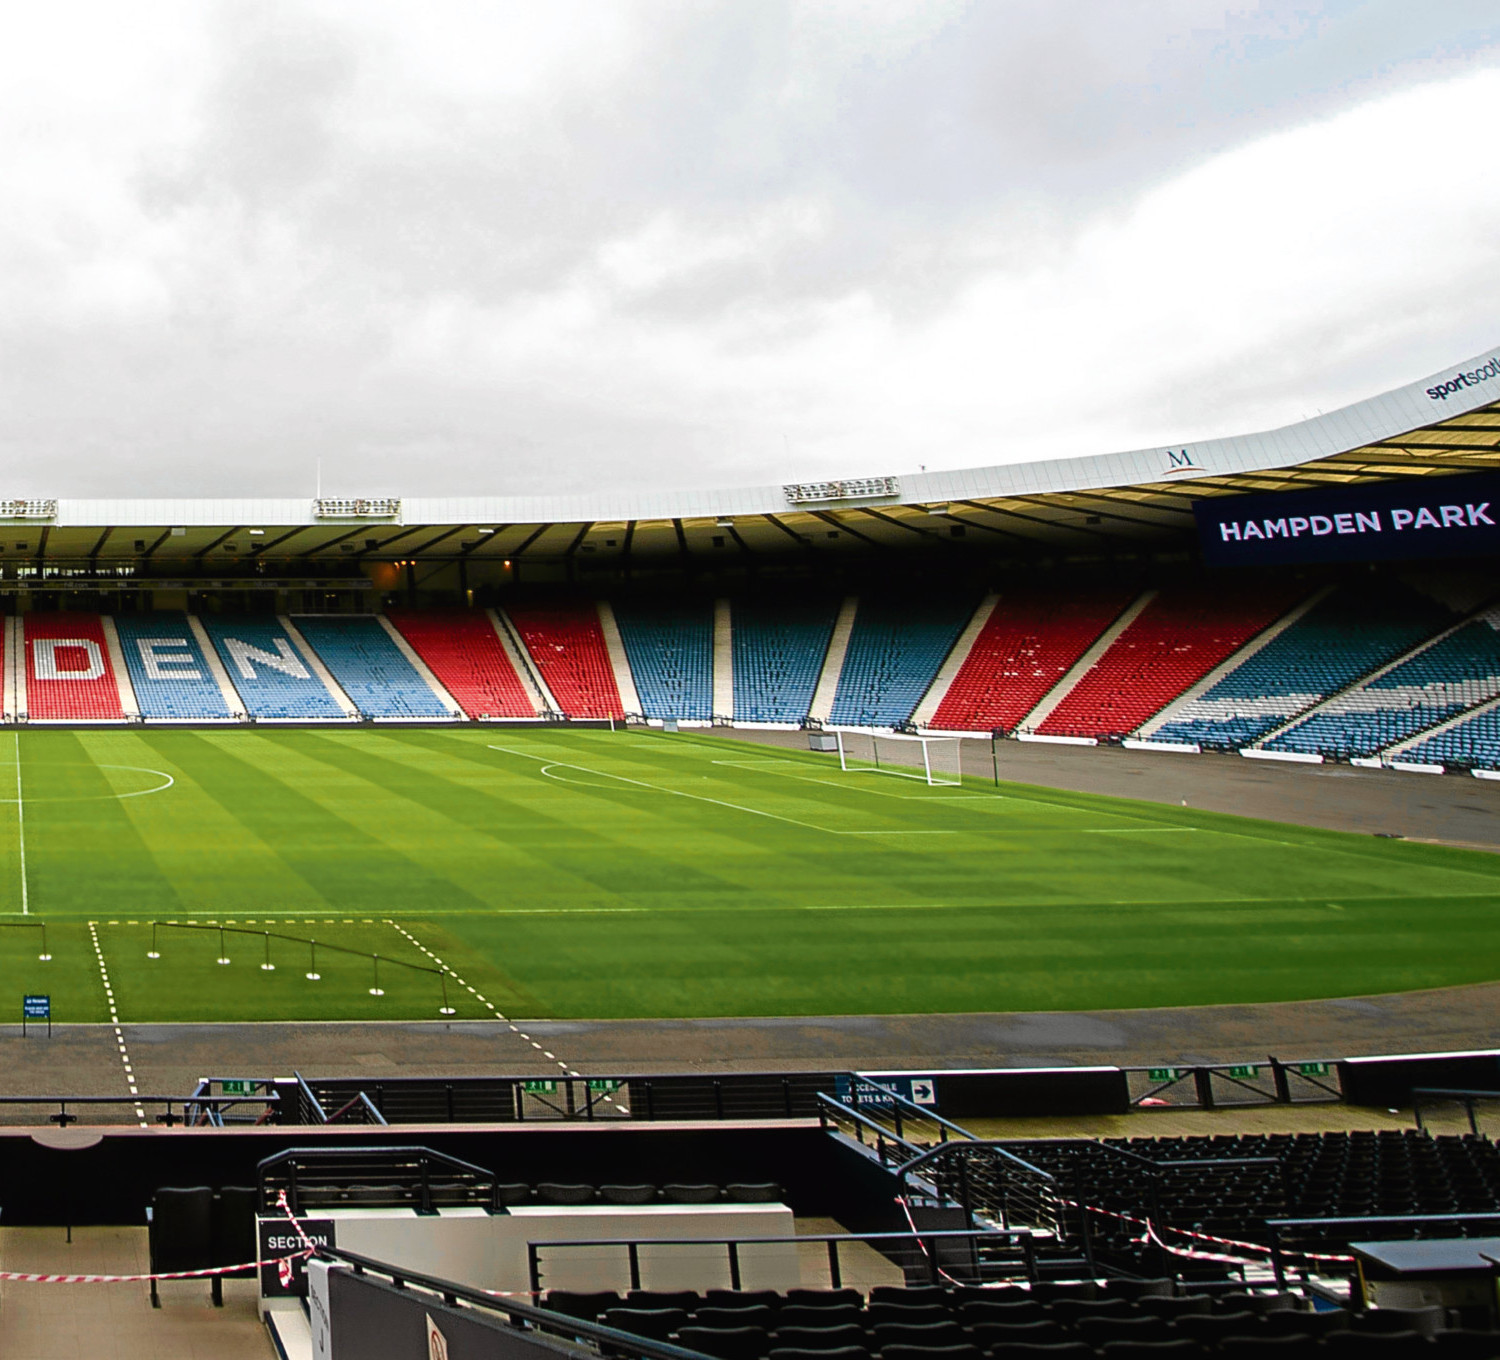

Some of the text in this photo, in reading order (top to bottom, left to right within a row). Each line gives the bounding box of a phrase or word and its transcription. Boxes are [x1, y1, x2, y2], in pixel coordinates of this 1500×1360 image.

[1426, 357, 1500, 400] sportscotl
[1220, 502, 1496, 541] HAMPDEN PARK
